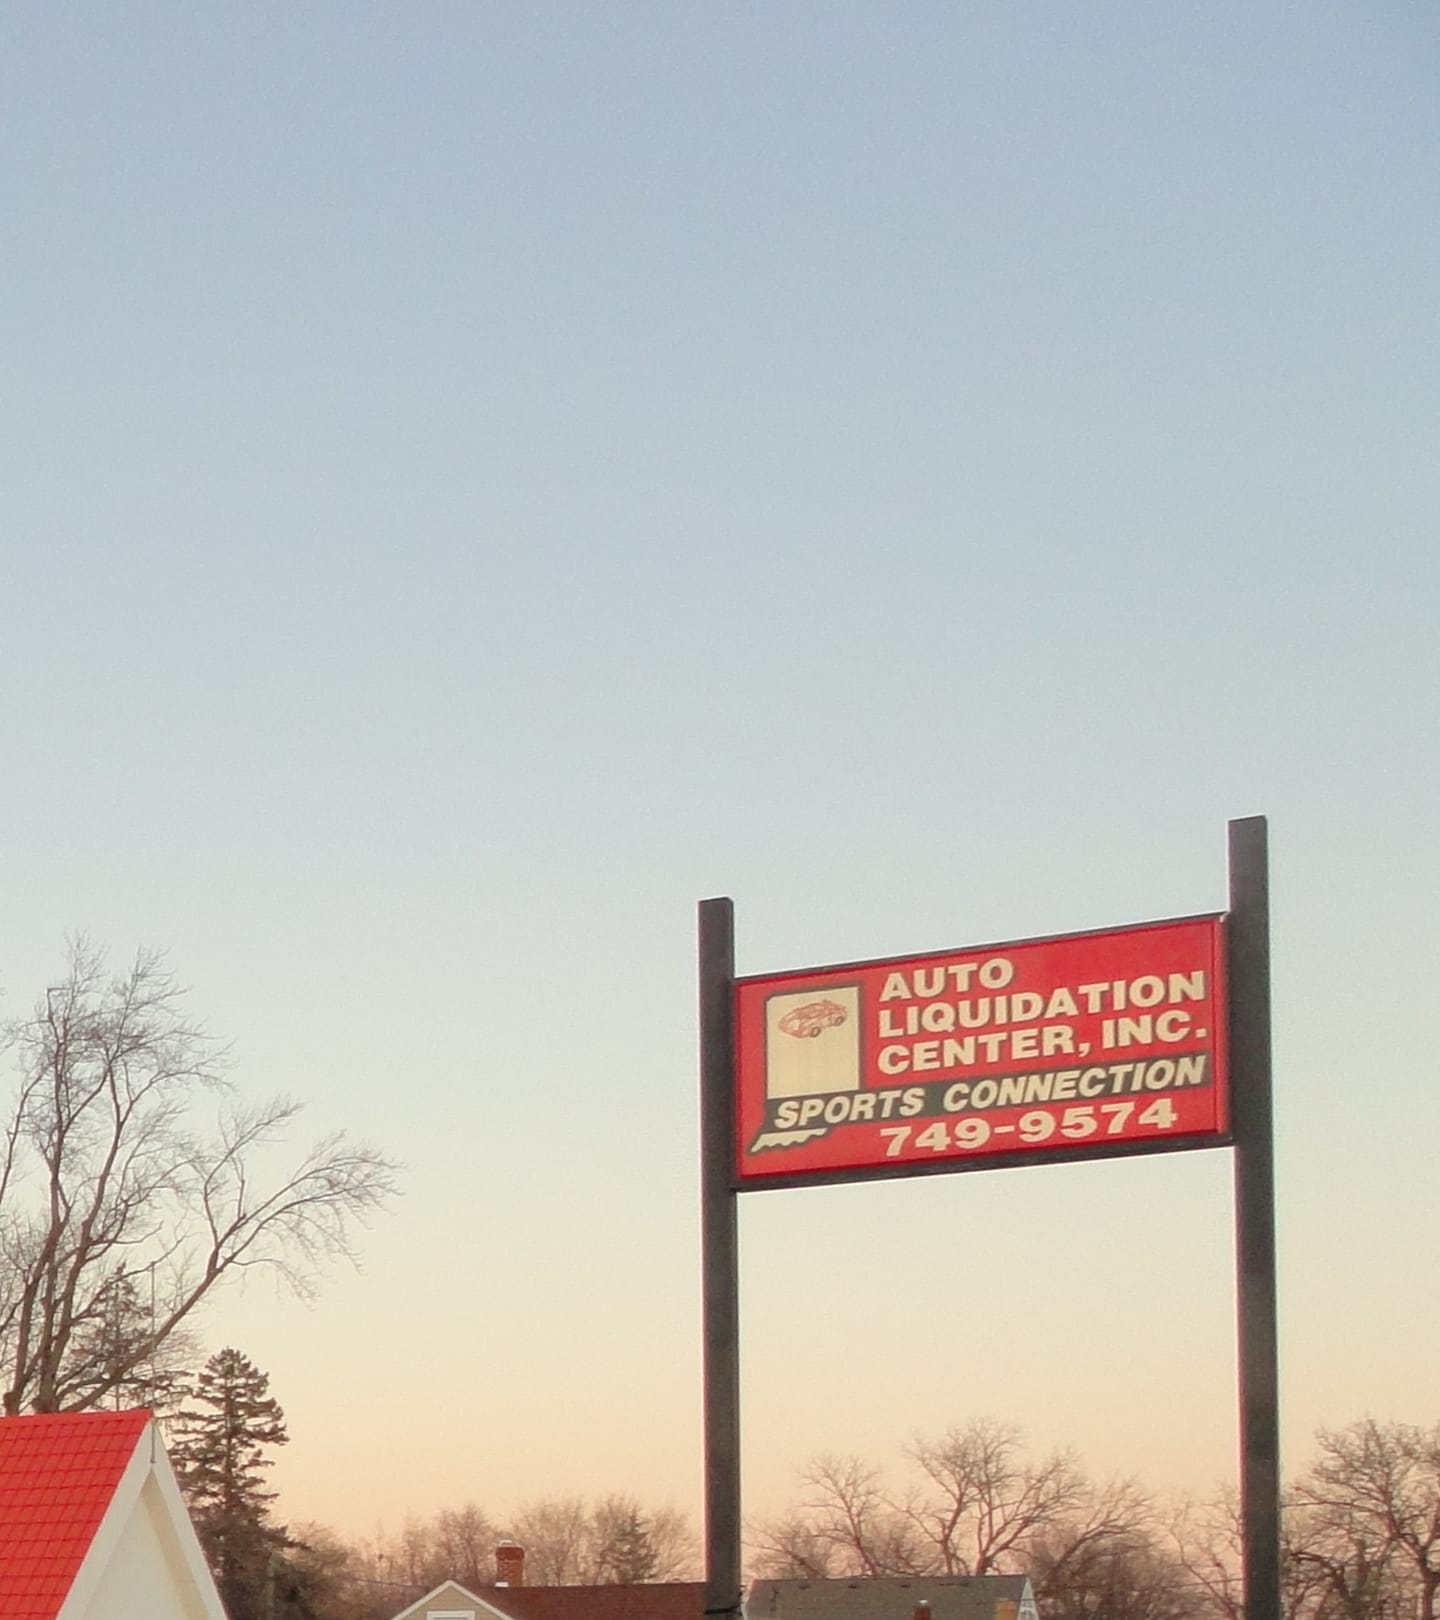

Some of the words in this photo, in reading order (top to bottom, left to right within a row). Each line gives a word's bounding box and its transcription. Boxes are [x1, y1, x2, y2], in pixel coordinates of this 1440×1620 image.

[879, 958, 1013, 1001] AUTO
[879, 970, 1205, 1038] LIQUIDATION
[878, 1024, 1091, 1075] CENTER,
[1102, 1010, 1207, 1048] INC.
[773, 1087, 926, 1129] SPORTS
[943, 1055, 1206, 1112] CONNECTION
[880, 1098, 1178, 1157] 749-9574
